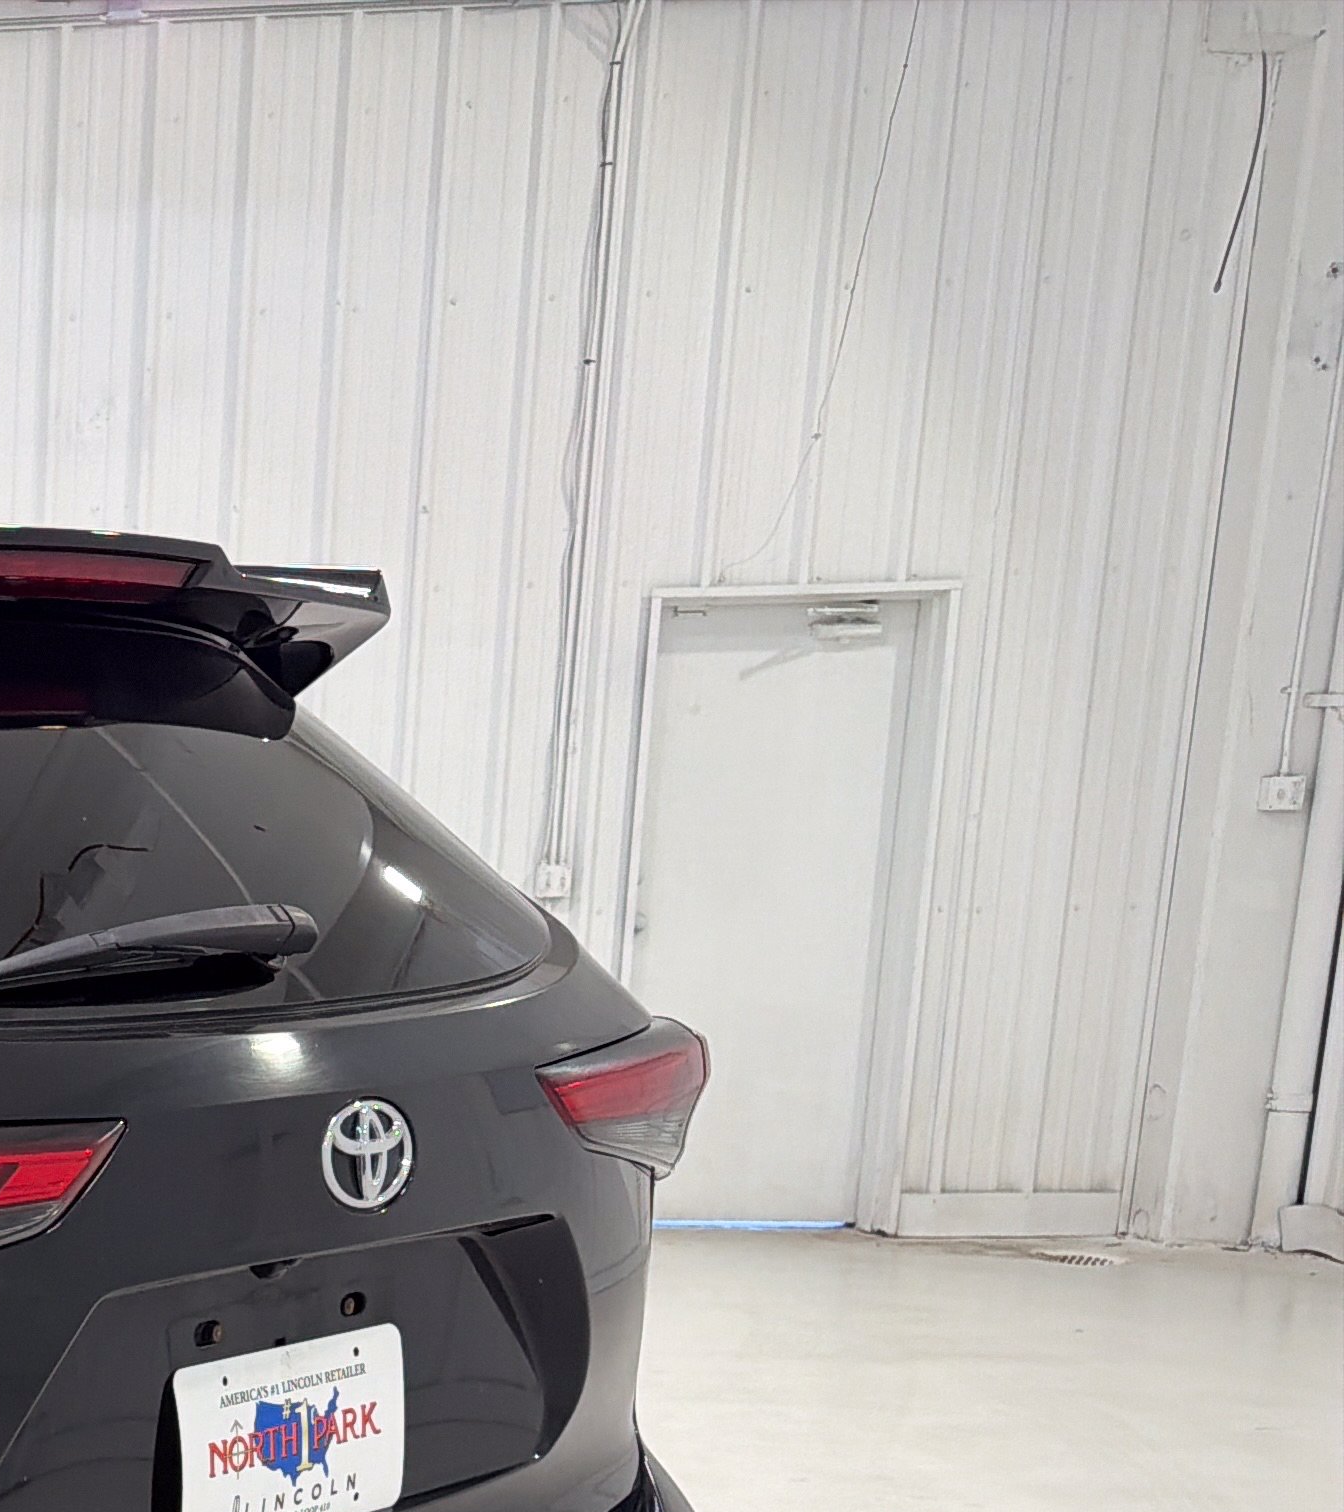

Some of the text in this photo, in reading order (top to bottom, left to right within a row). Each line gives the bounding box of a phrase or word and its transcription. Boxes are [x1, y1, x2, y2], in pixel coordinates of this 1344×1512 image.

[219, 1363, 366, 1409] AMERICA'S #1 LINCOLN RETAILER
[208, 1401, 382, 1478] NORTH PARK
